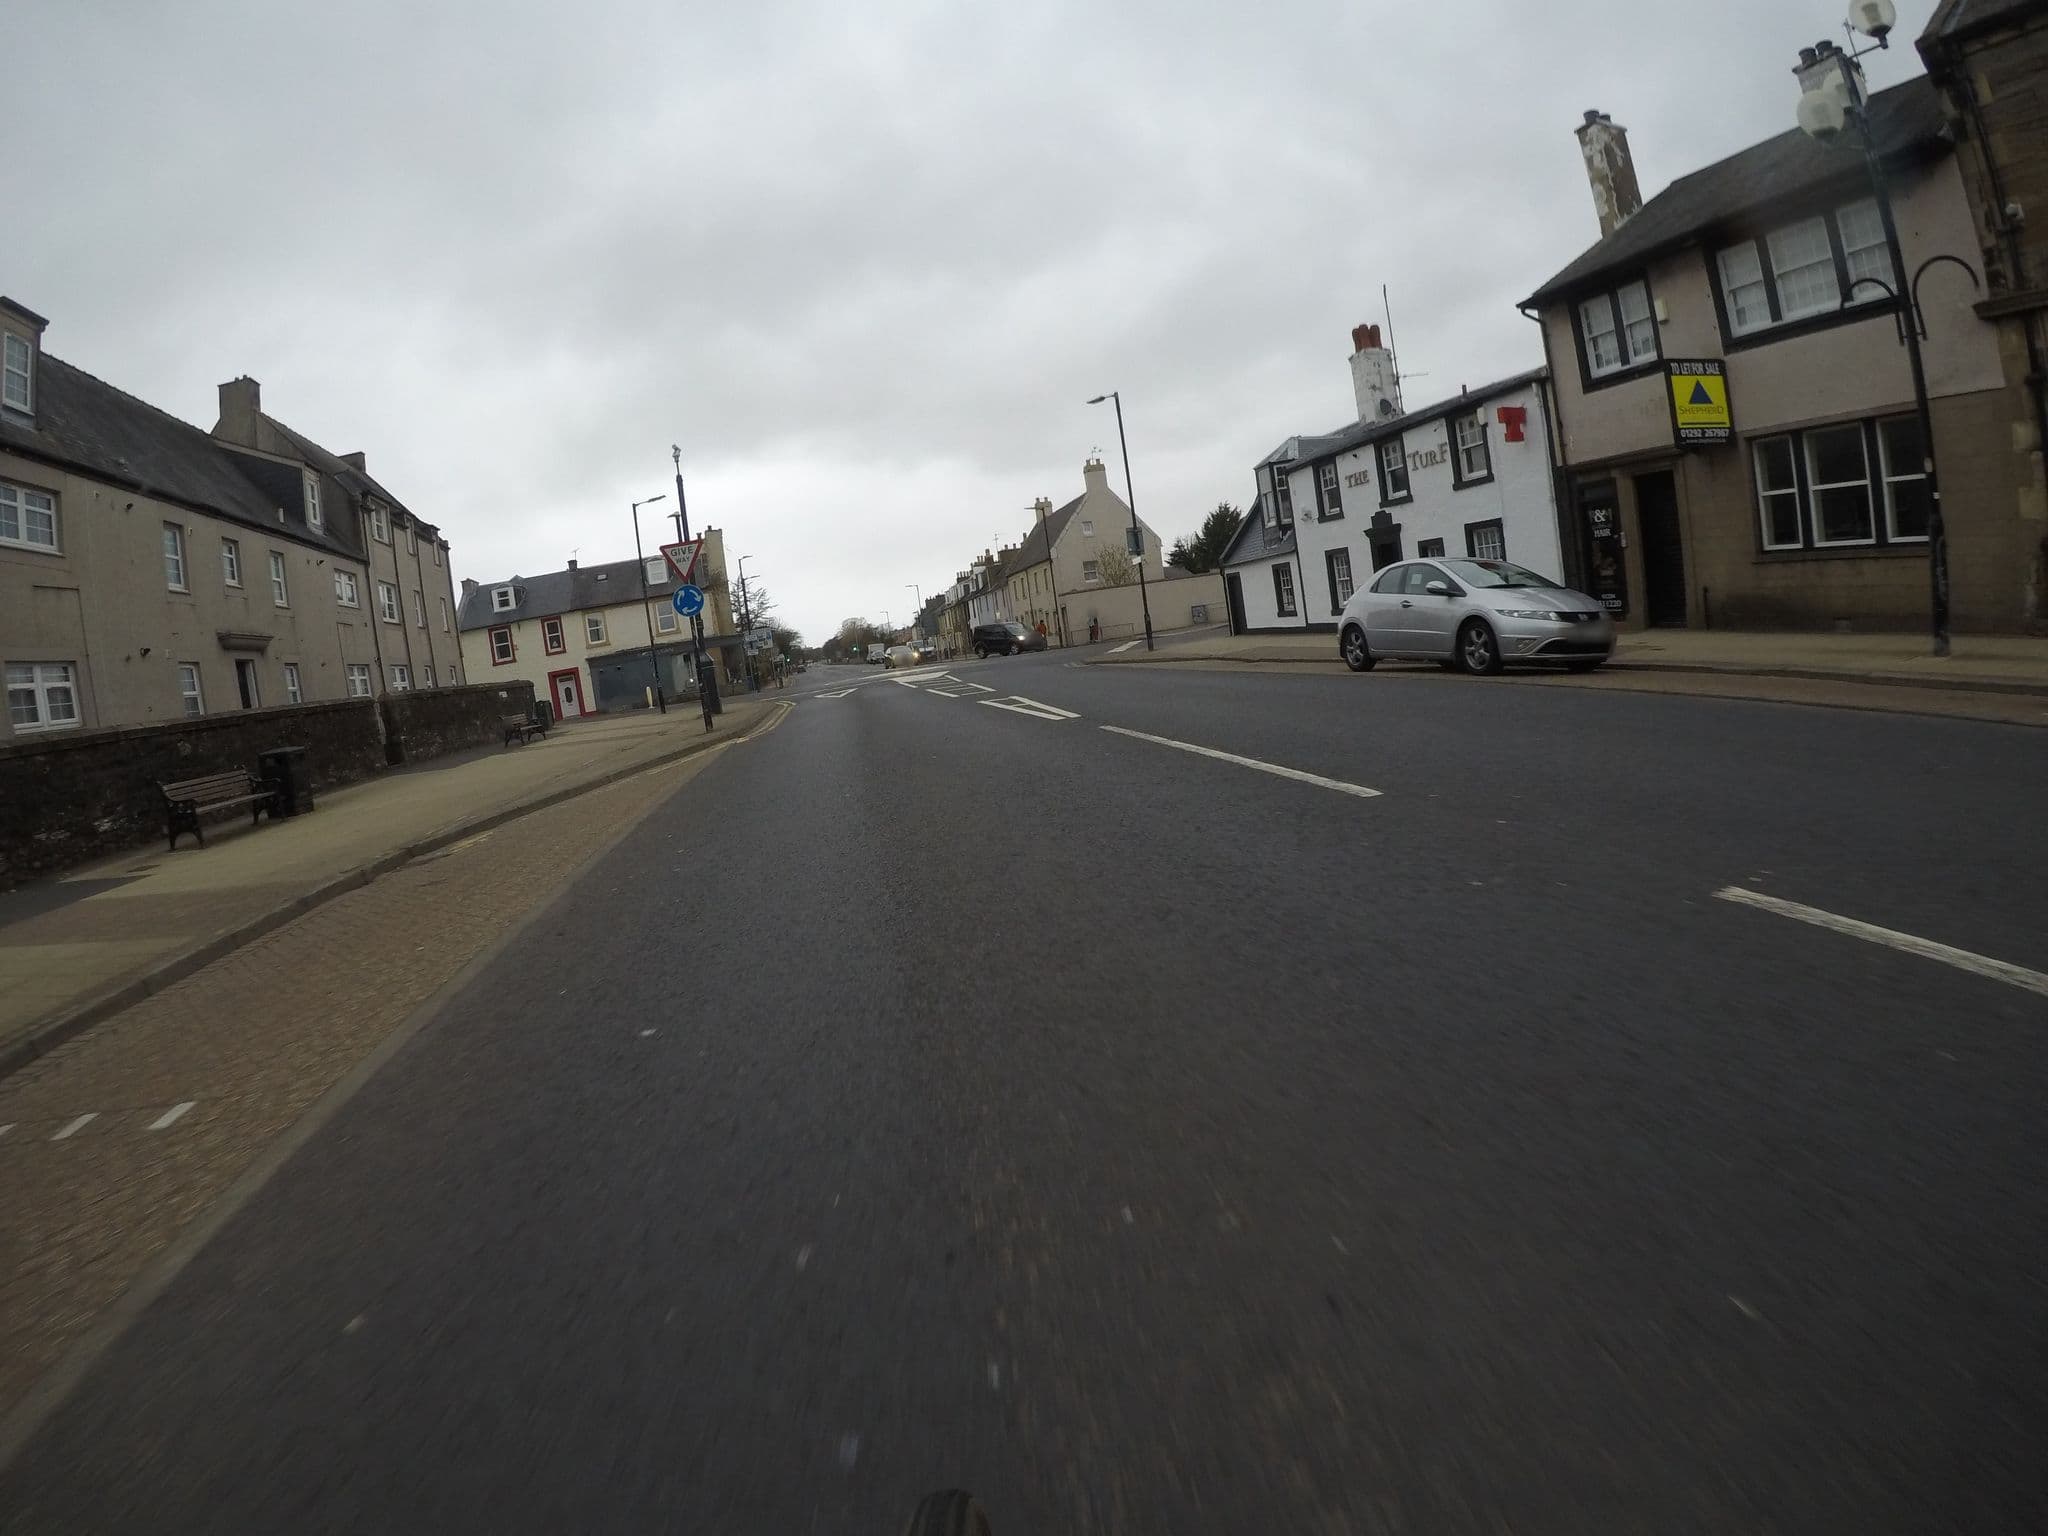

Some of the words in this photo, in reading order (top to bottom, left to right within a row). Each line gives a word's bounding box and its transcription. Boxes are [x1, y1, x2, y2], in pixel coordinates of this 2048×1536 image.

[1671, 362, 1680, 374] TO
[1705, 362, 1720, 374] SALE
[1679, 405, 1724, 415] SHEPHERD
[1344, 469, 1370, 488] THE
[1407, 442, 1448, 471] TURF
[671, 546, 694, 557] GIVE
